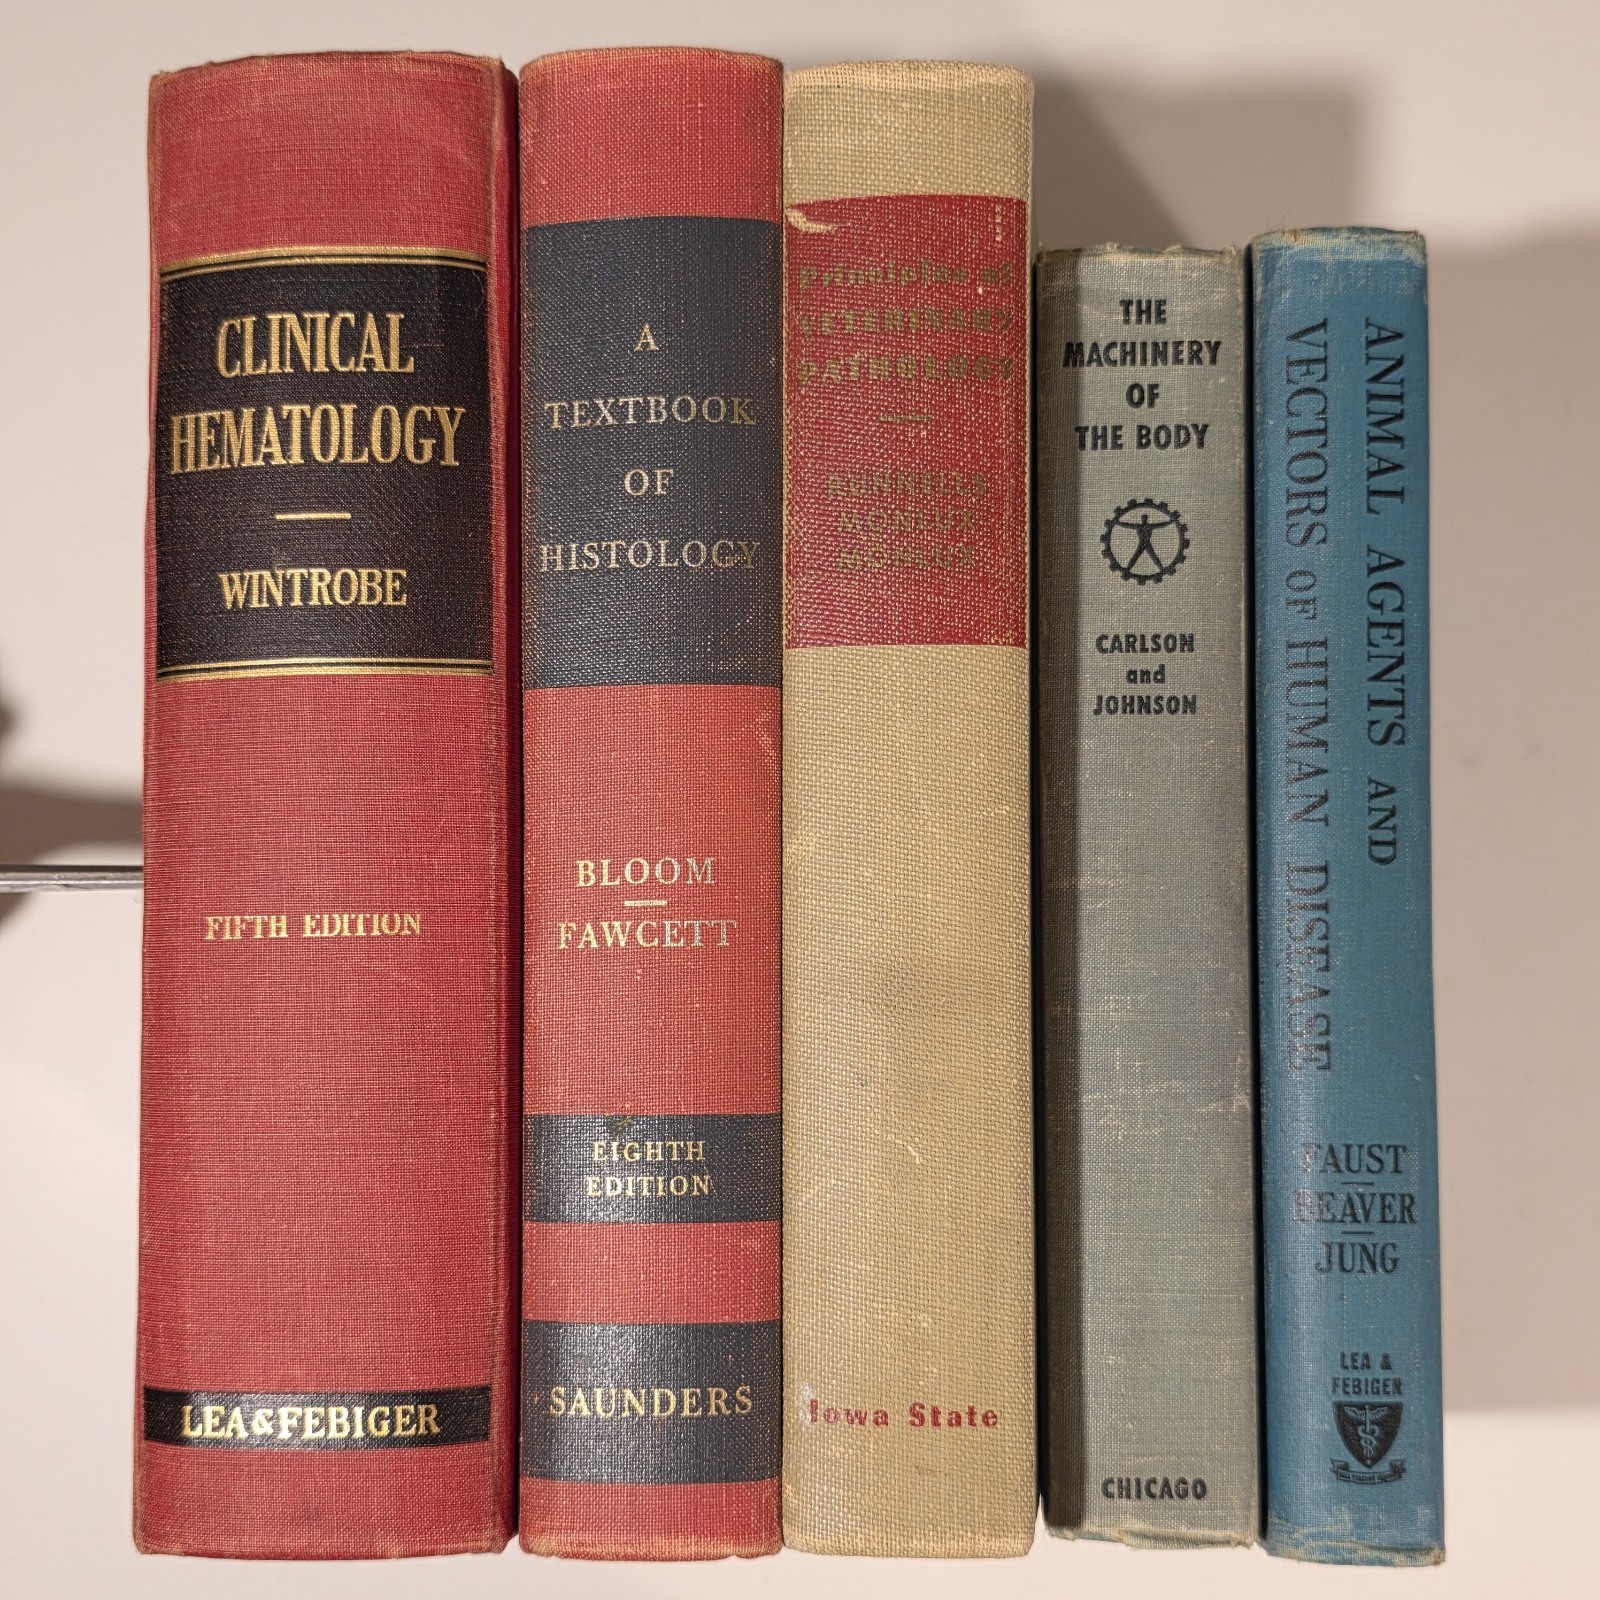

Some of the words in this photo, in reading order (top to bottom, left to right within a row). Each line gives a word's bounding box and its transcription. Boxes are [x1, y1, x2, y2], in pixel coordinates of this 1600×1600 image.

[799, 307, 1014, 337] VETERINARY
[1120, 299, 1167, 325] THE
[217, 311, 414, 379] CLINICAL
[635, 323, 660, 351] A
[1063, 340, 1222, 368] MACHINERY
[799, 355, 1014, 385] PATHOLOGY
[1125, 383, 1159, 409] OF
[544, 395, 756, 429] TEXTBOOK
[1365, 317, 1404, 515] ANIMAL
[169, 403, 466, 475] HEMATOLOGY
[1075, 424, 1123, 451] THE
[1136, 423, 1209, 450] BODY
[1285, 317, 1328, 548] VECTORS
[624, 468, 674, 496] OF
[826, 471, 988, 499] RUNNELLS
[837, 509, 975, 533] MONLUX
[539, 539, 760, 573] HISTOLOGY
[836, 545, 976, 570] MONLUX
[218, 567, 407, 609] WINTROBE
[1285, 569, 1317, 620] OF
[1095, 633, 1195, 654] CARLSON
[1366, 543, 1405, 747] AGENTS
[1125, 664, 1166, 684] and
[1093, 695, 1197, 716] JOHNSON
[1285, 637, 1329, 828] HUMAN
[1367, 777, 1397, 866] AND
[576, 857, 717, 888] BLOOM
[205, 915, 288, 940] FIFTH
[303, 912, 421, 937] EDITION
[559, 920, 737, 950] FAWCETT
[1286, 859, 1332, 1072] DISEASE
[592, 1140, 705, 1163] EIGHTH
[1300, 1142, 1408, 1174] FAUST
[587, 1175, 711, 1197] EDITION
[1294, 1188, 1418, 1224] BEAVER
[1315, 1241, 1400, 1274] JUNG
[1340, 1351, 1371, 1370] LEA
[1380, 1352, 1393, 1370] &
[549, 1385, 753, 1418] SAUNDERS
[809, 1398, 889, 1426] Iowa
[908, 1402, 998, 1428] State
[1101, 1476, 1207, 1500] CHICAGO
